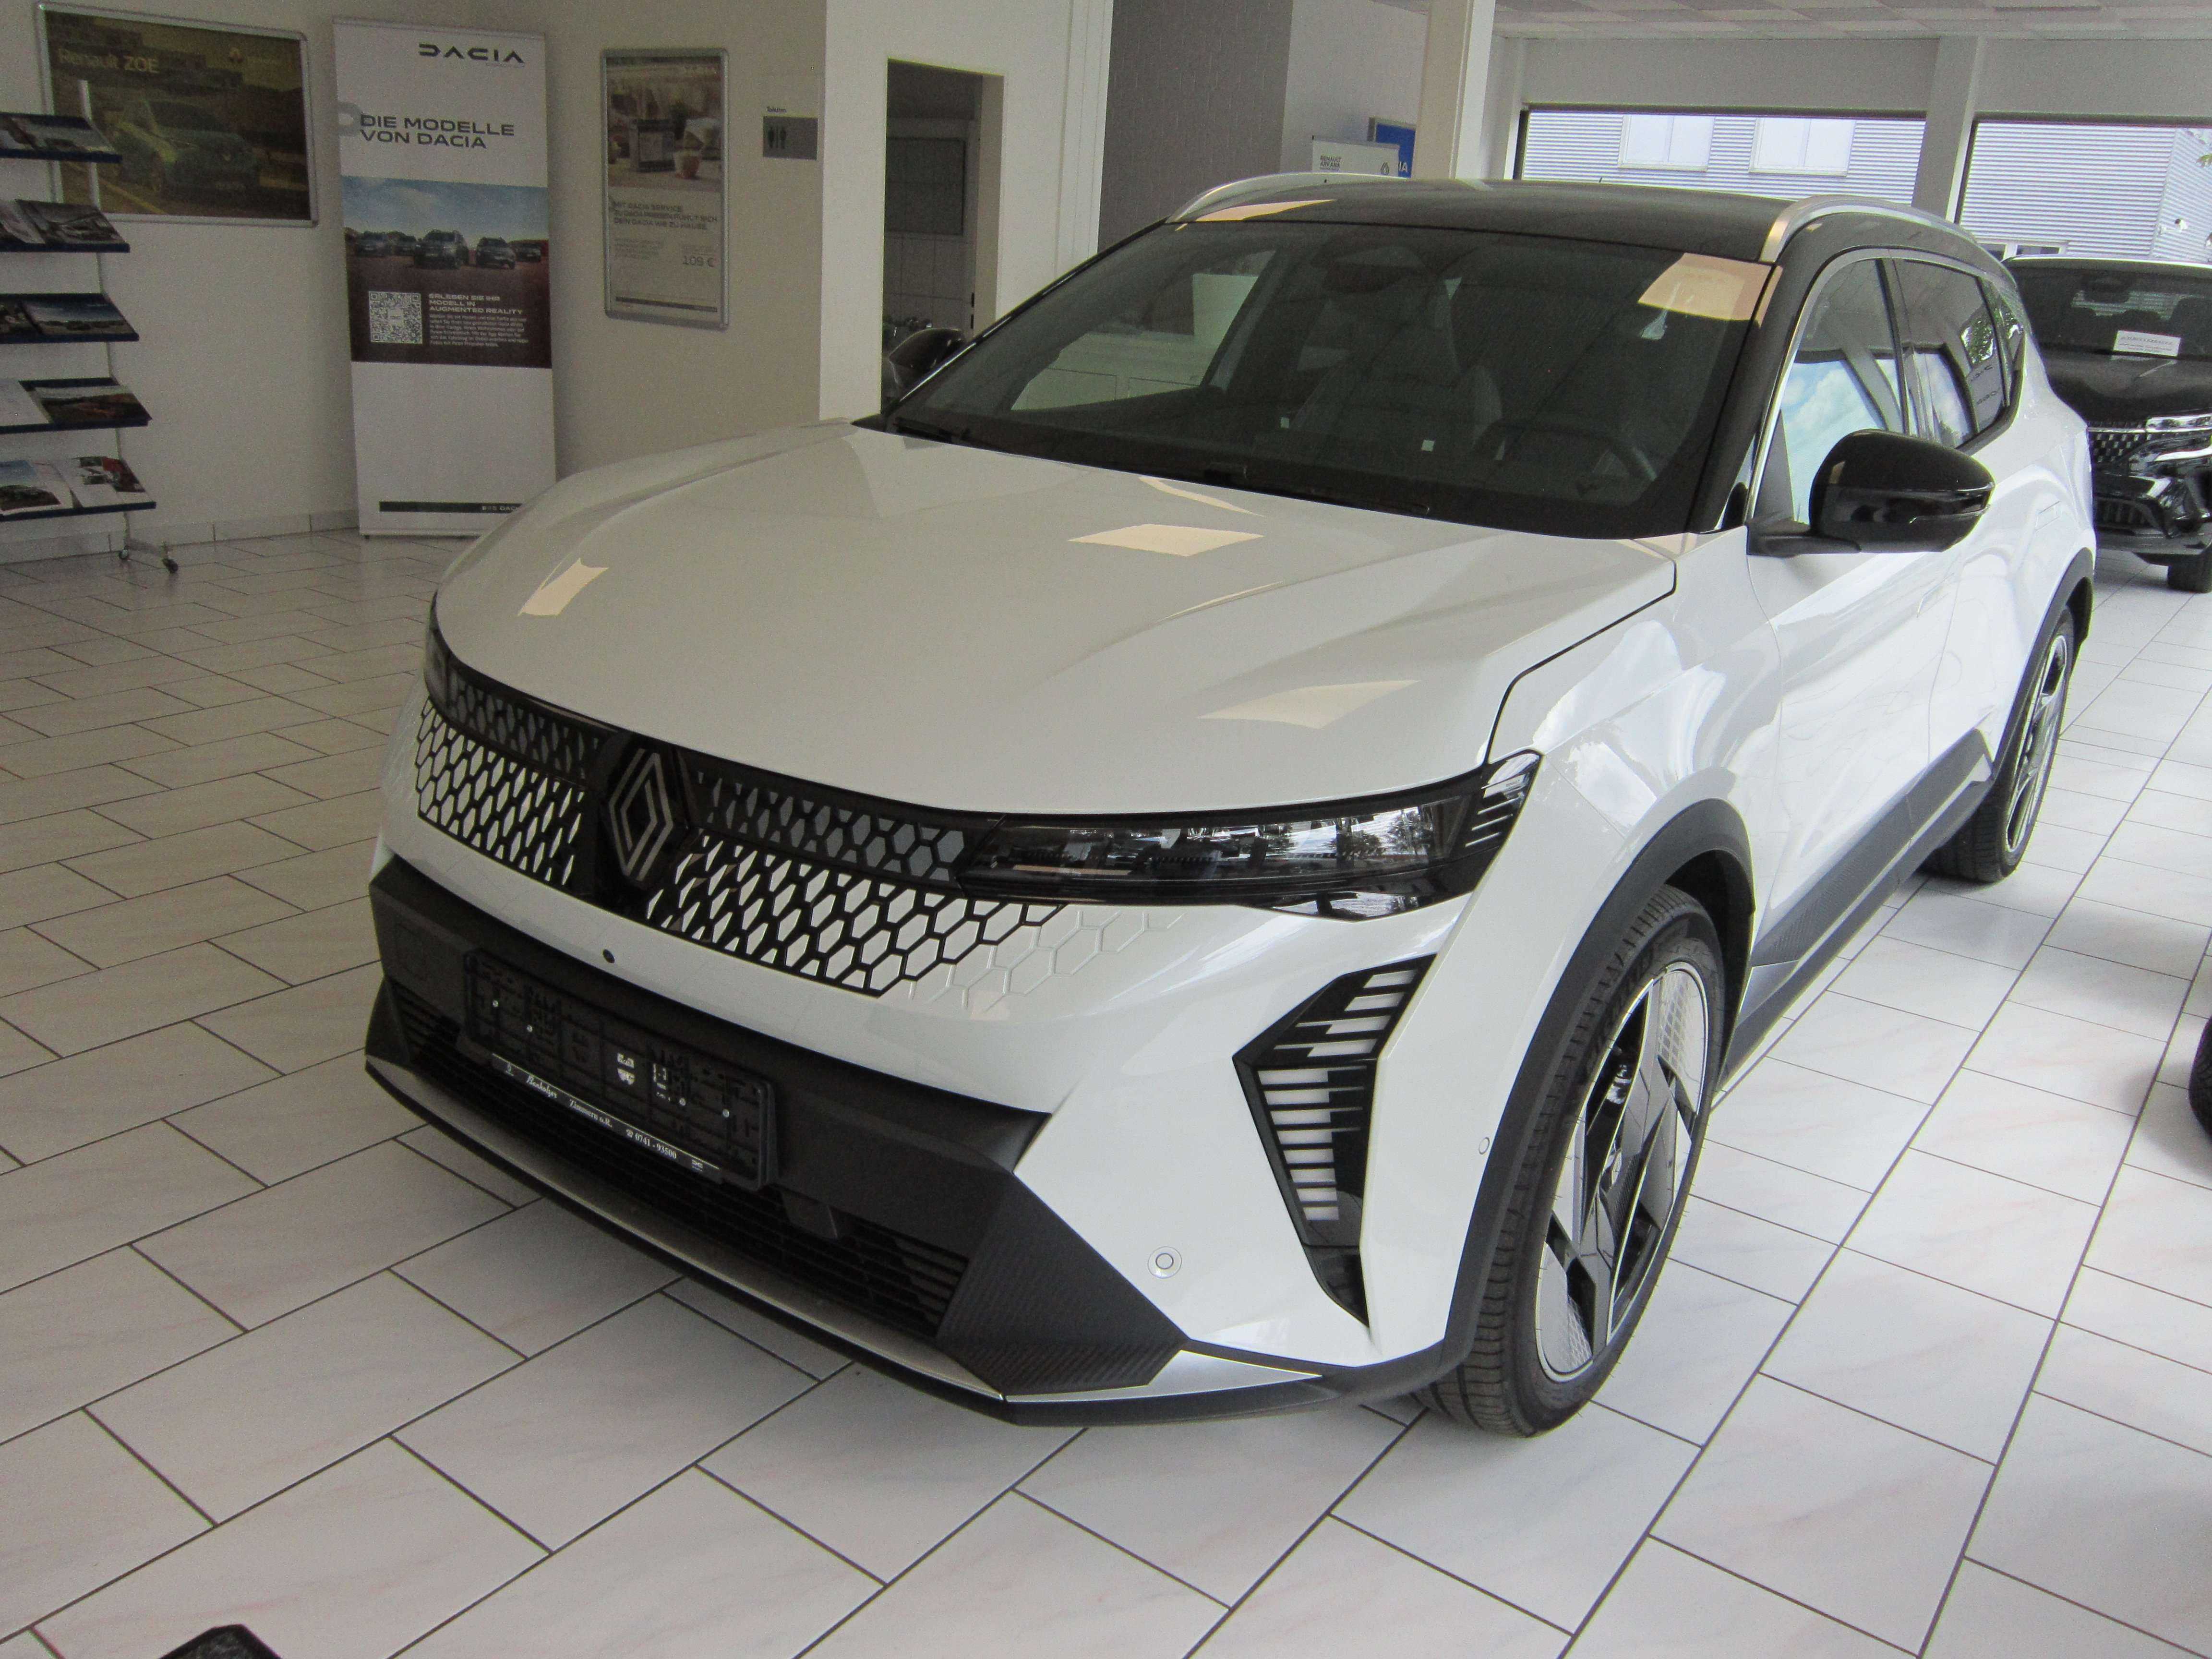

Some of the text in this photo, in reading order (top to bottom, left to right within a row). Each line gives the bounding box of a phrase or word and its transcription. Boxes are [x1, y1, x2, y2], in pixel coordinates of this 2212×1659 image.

[419, 43, 524, 63] DACIA
[123, 55, 160, 74] ZOE
[361, 114, 514, 136] DIE MODELLE
[361, 129, 487, 149] VON DACIA
[635, 1132, 651, 1147] 0741
[656, 1143, 677, 1159] 93500
